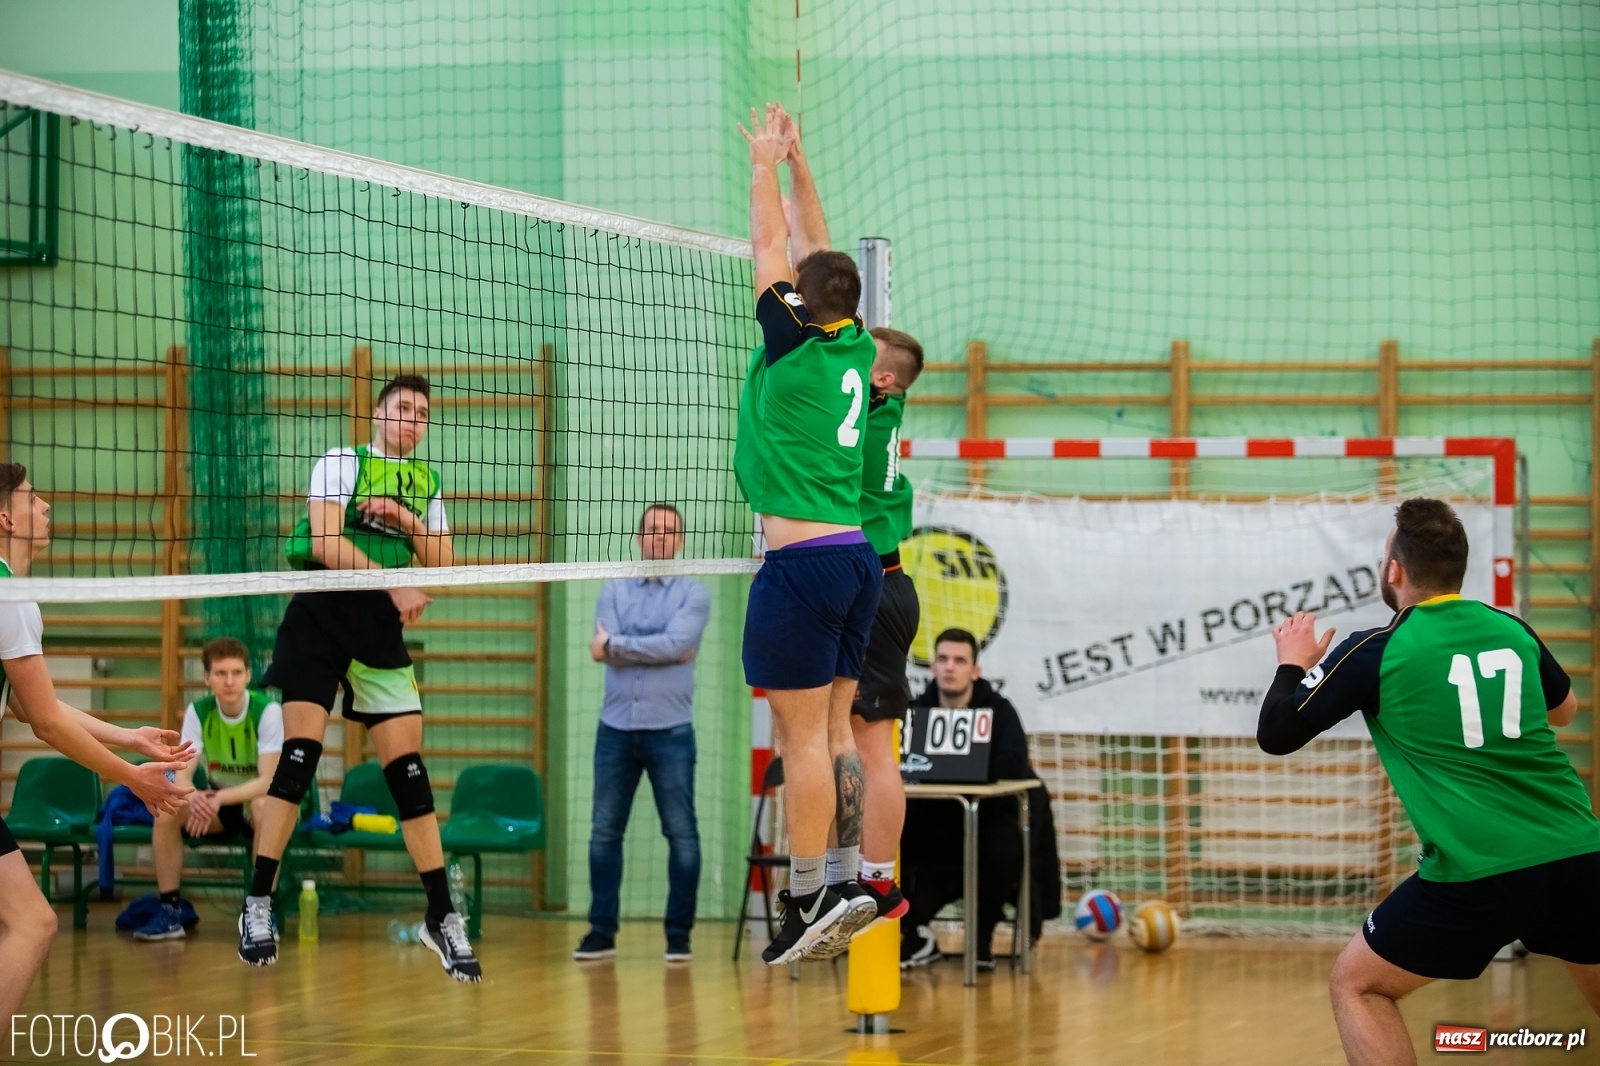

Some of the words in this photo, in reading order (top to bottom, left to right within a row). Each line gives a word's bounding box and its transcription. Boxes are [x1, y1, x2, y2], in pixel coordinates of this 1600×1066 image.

[837, 368, 863, 448] 2
[1036, 632, 1137, 694] JEST
[1147, 617, 1188, 656] W
[1200, 558, 1382, 644] PORZĄD
[931, 715, 969, 751] 06
[976, 713, 991, 739] 0
[1447, 648, 1524, 749] 17
